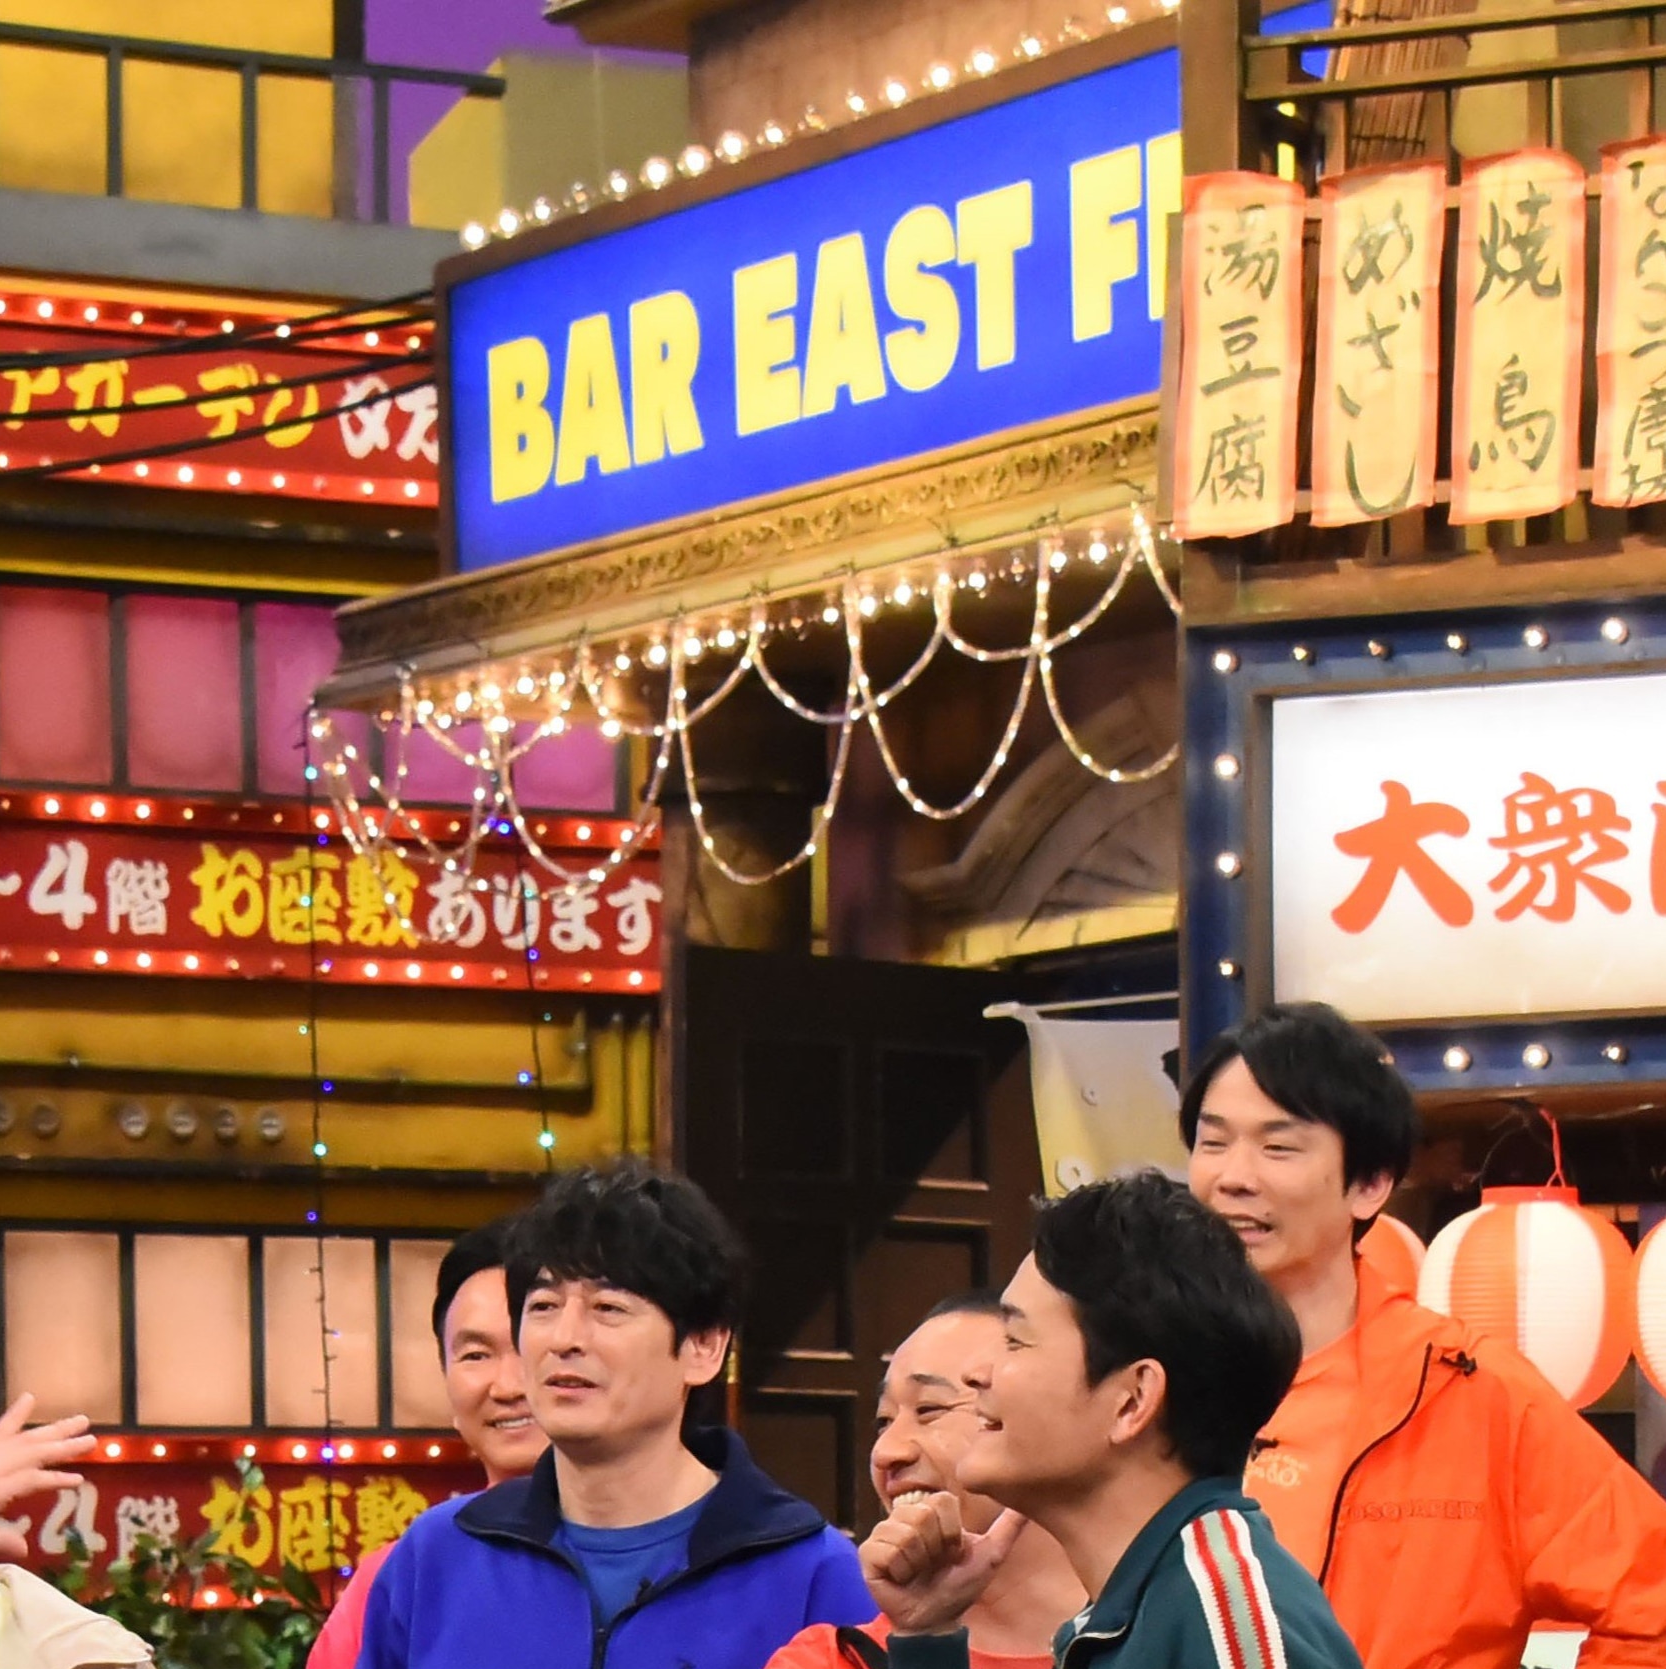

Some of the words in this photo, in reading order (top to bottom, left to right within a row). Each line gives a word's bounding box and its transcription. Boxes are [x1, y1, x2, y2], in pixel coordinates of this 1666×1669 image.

[488, 290, 704, 505] BAR
[734, 179, 1033, 438] EAST
[1200, 203, 1280, 506] 湯豆腐
[1339, 203, 1421, 518] めざし
[1470, 182, 1562, 473] 焼鳥
